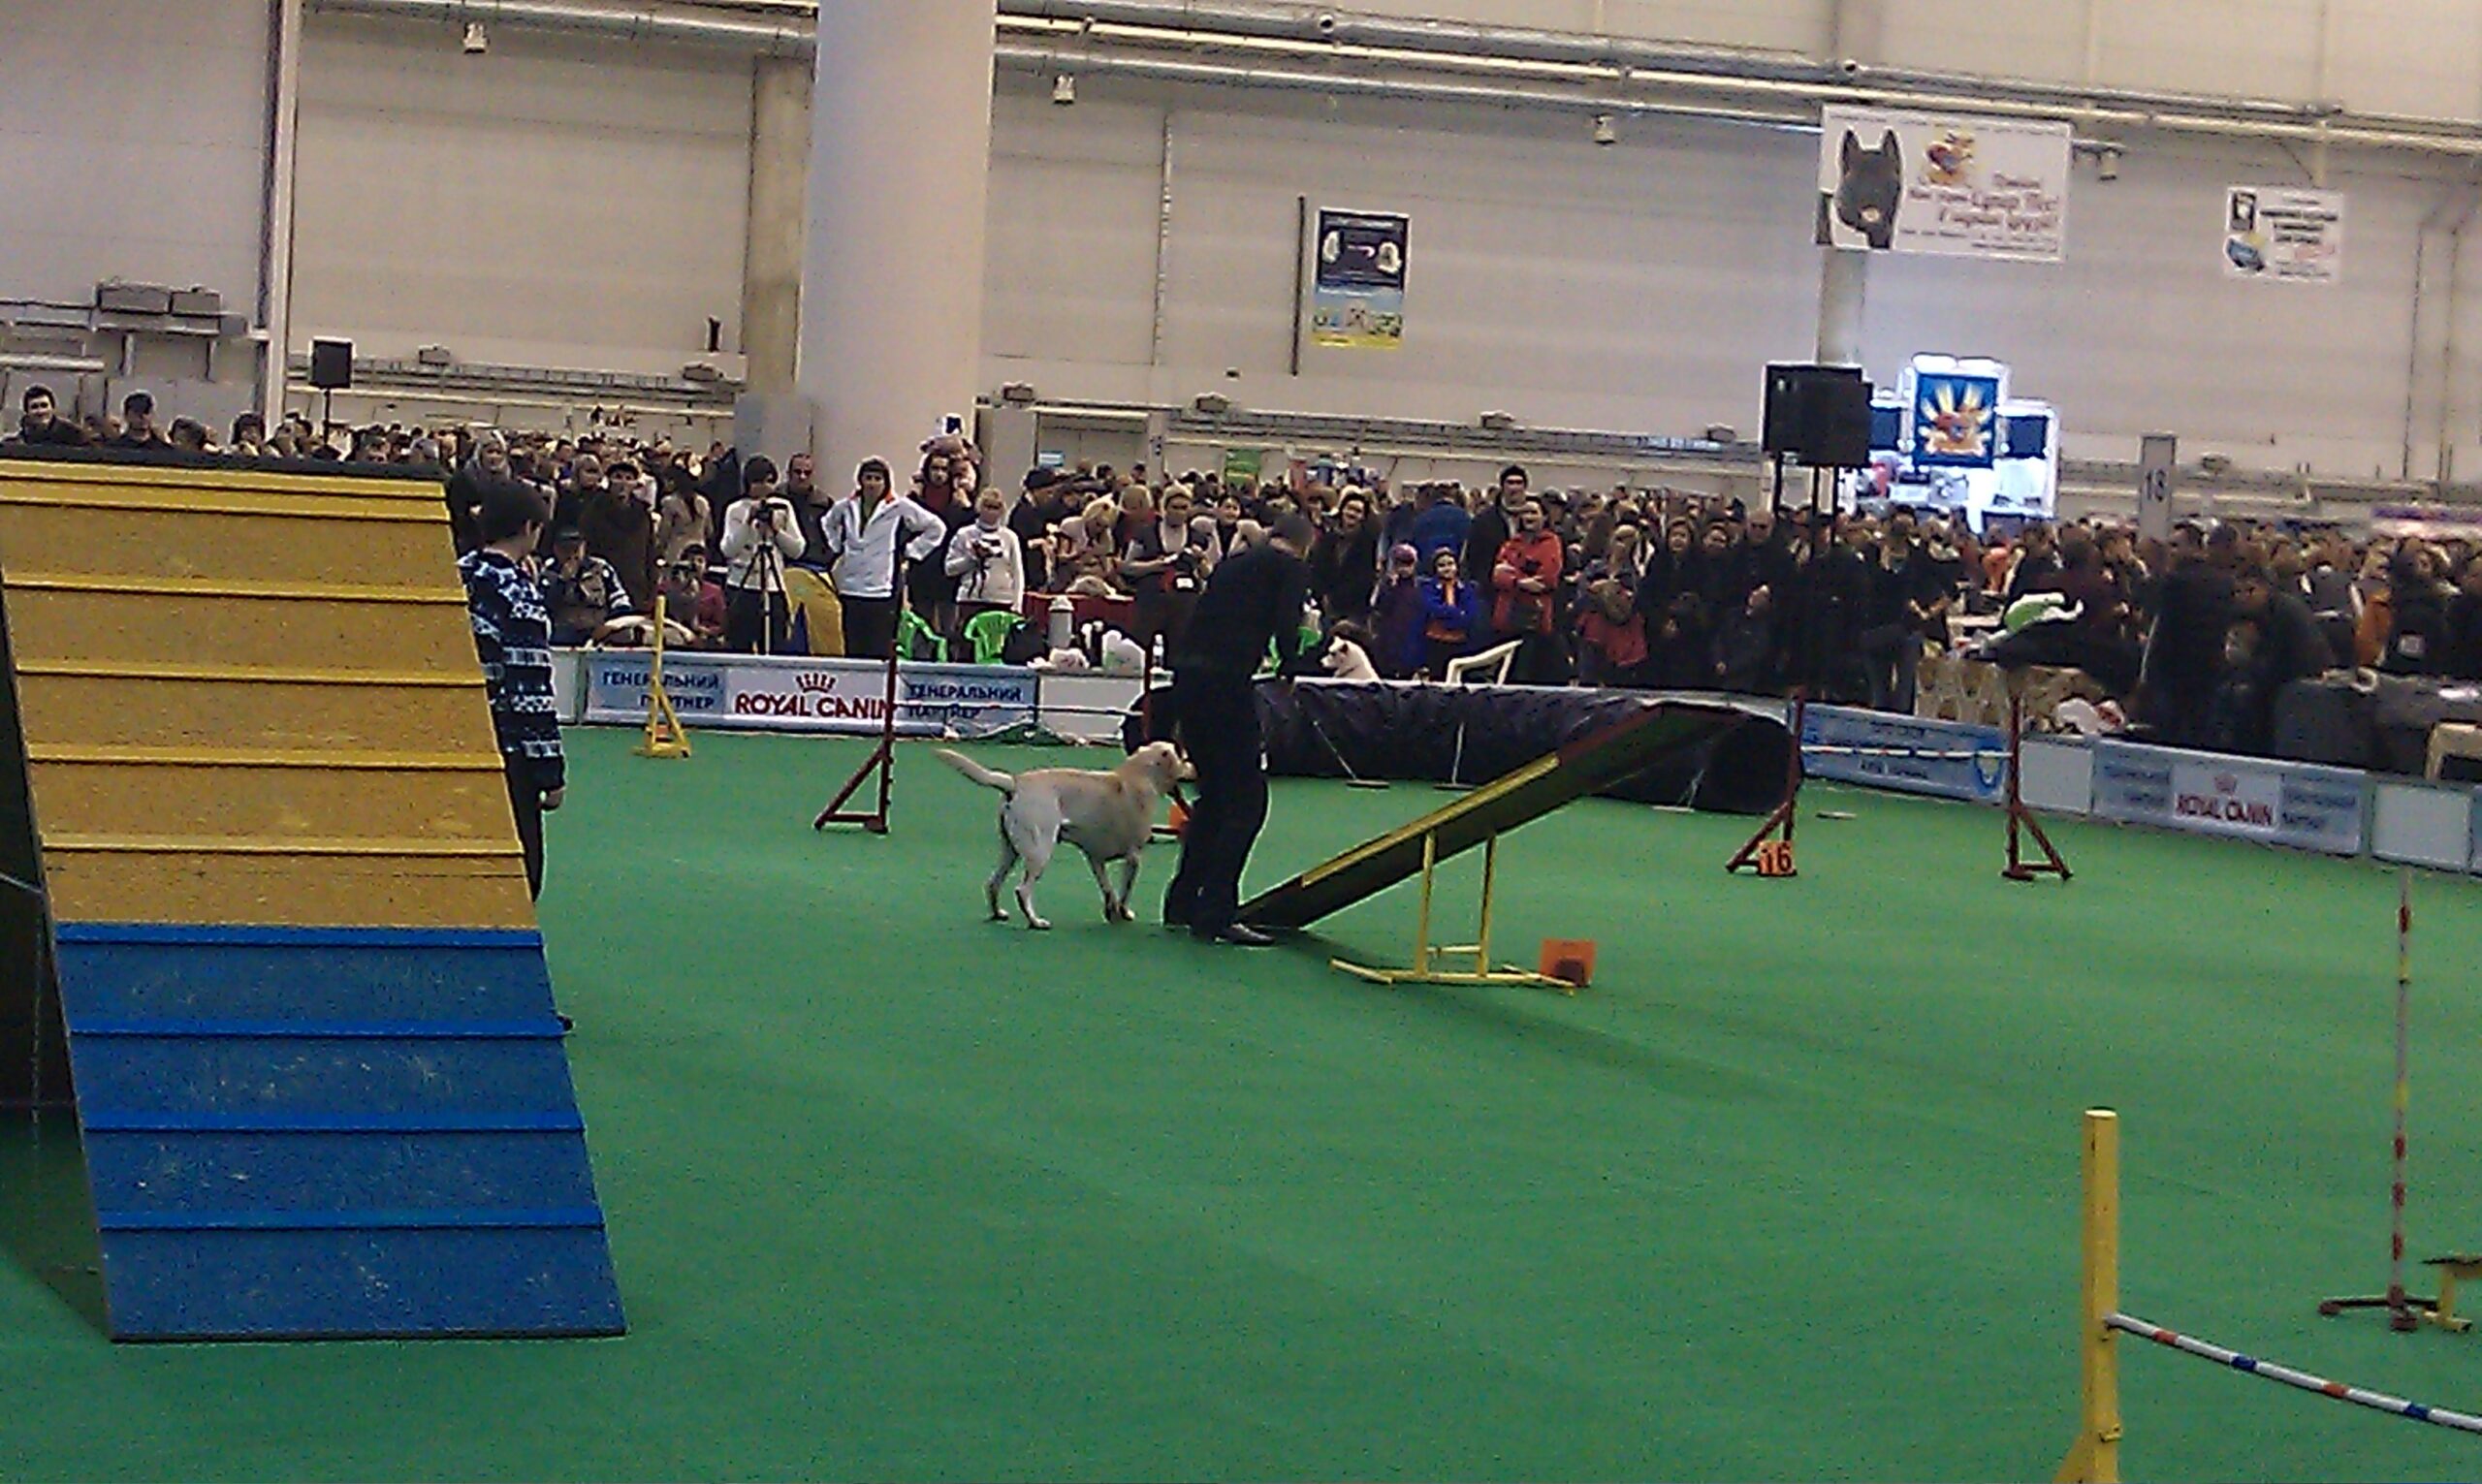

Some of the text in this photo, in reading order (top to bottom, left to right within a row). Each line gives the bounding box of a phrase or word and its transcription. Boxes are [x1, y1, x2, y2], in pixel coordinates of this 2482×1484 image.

[602, 670, 719, 689] ГЕНЕРЛЬНИЙ
[735, 692, 812, 717] ROYAL
[1761, 841, 1792, 873] 16
